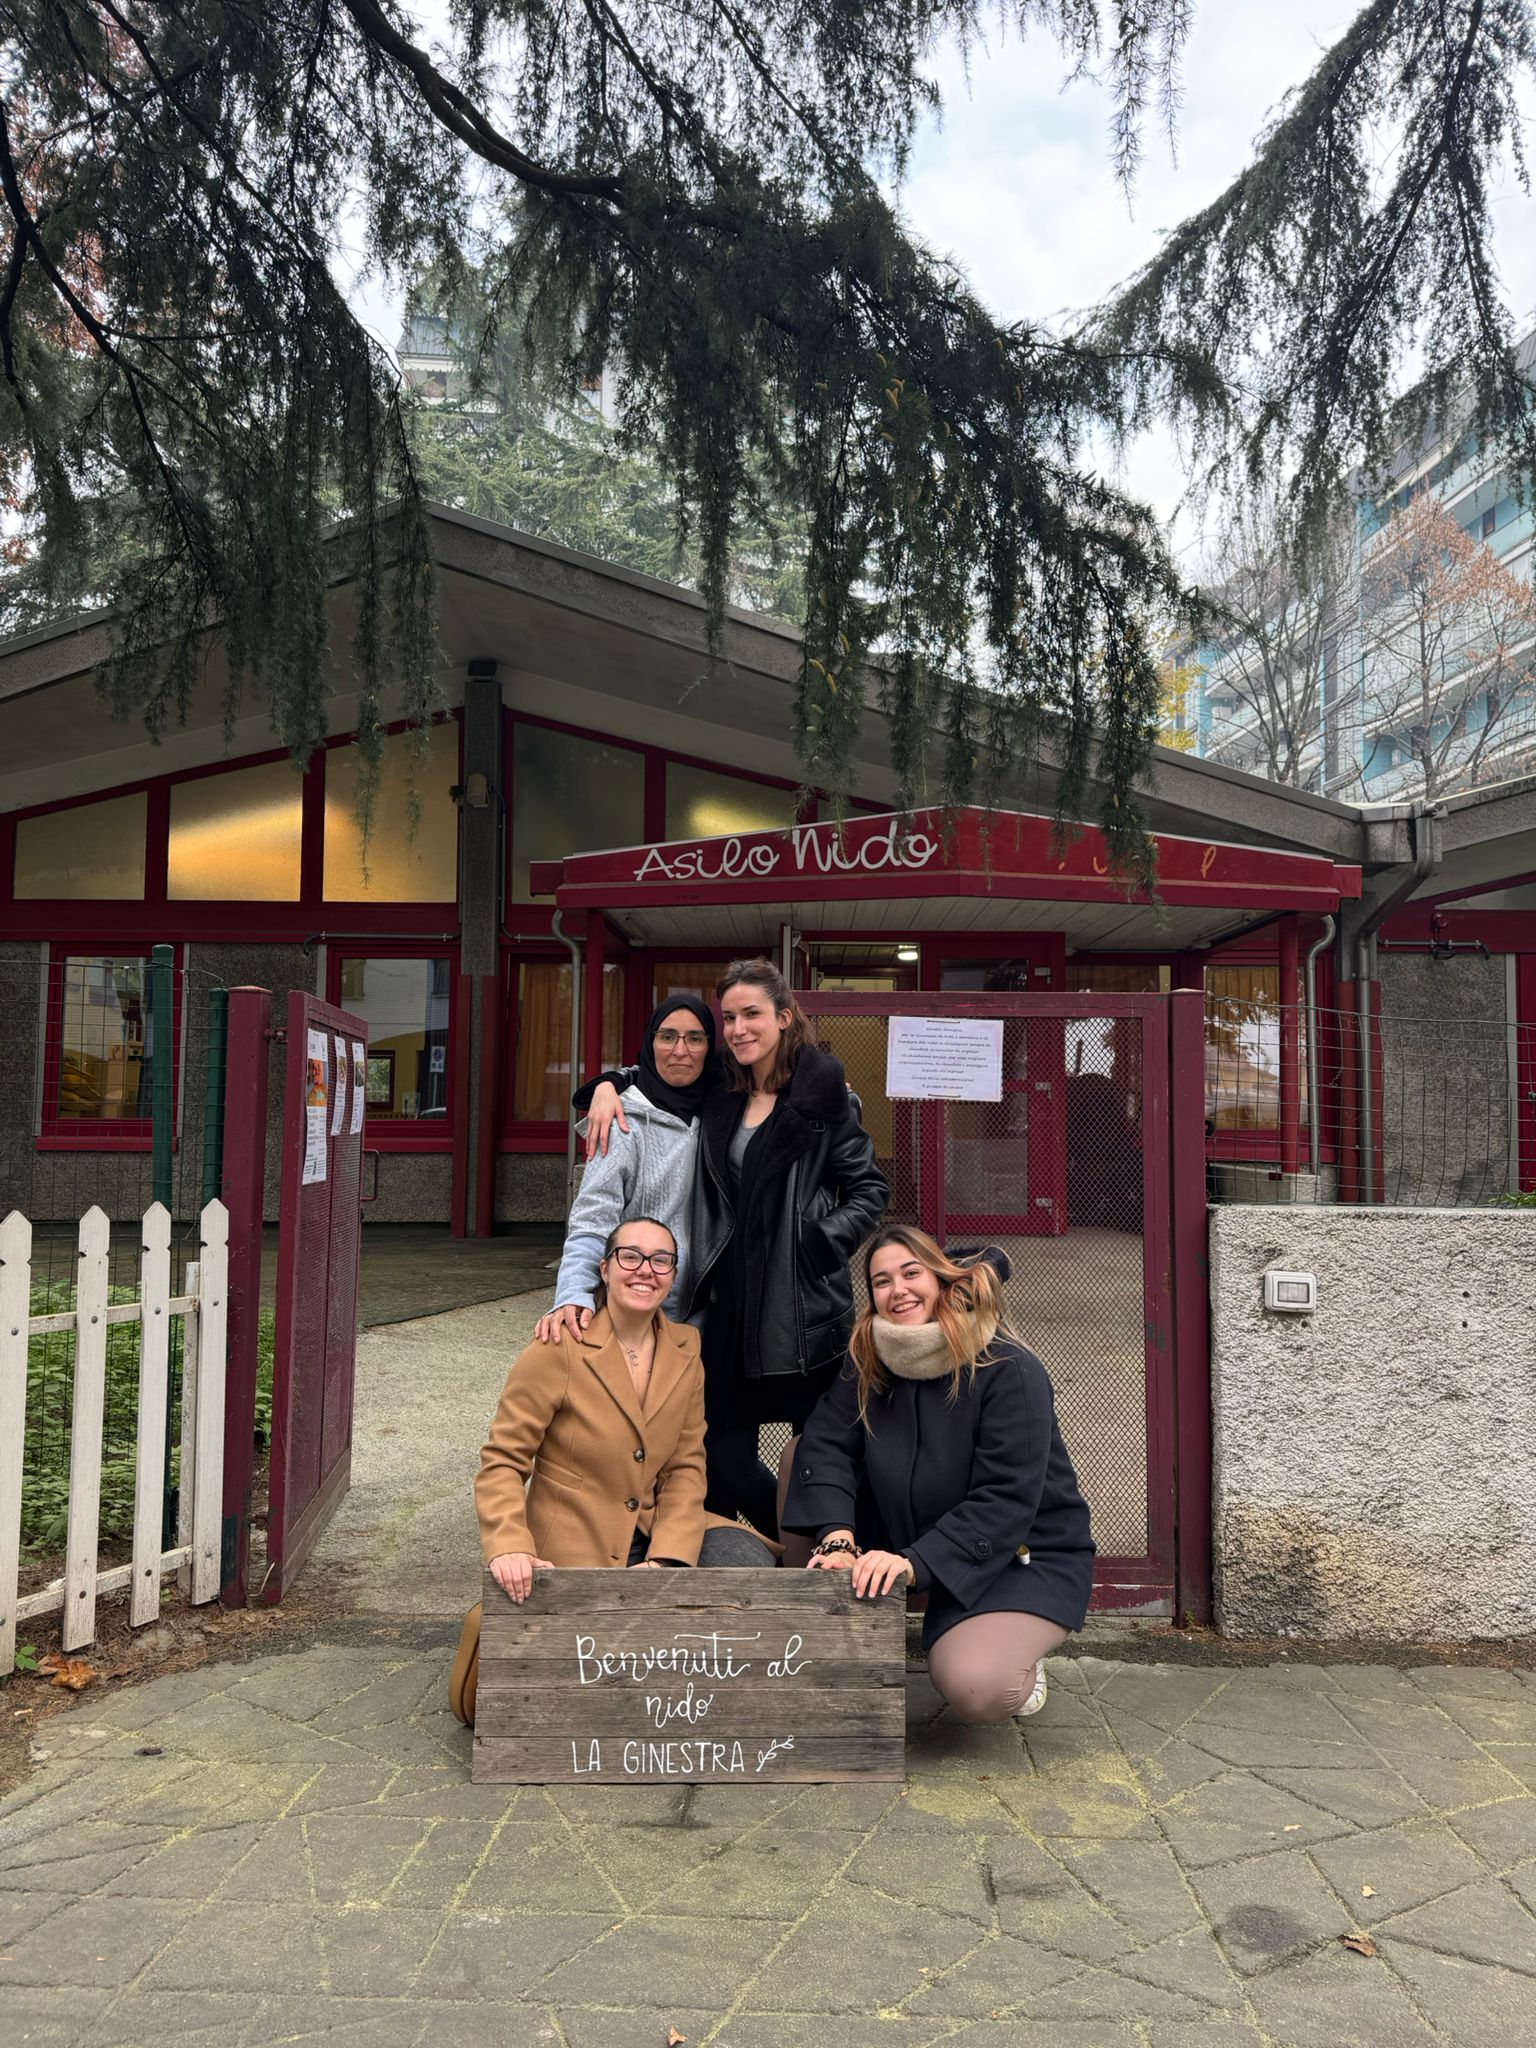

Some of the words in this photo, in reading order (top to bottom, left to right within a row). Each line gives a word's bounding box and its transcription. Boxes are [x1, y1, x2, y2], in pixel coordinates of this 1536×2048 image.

[633, 837, 780, 882] Asilo
[792, 819, 939, 873] Nido
[575, 1631, 762, 1685] Benvenuti
[766, 1634, 813, 1678] al
[645, 1681, 715, 1729] nido
[571, 1738, 602, 1774] LA
[623, 1740, 746, 1775] GINESTRA
